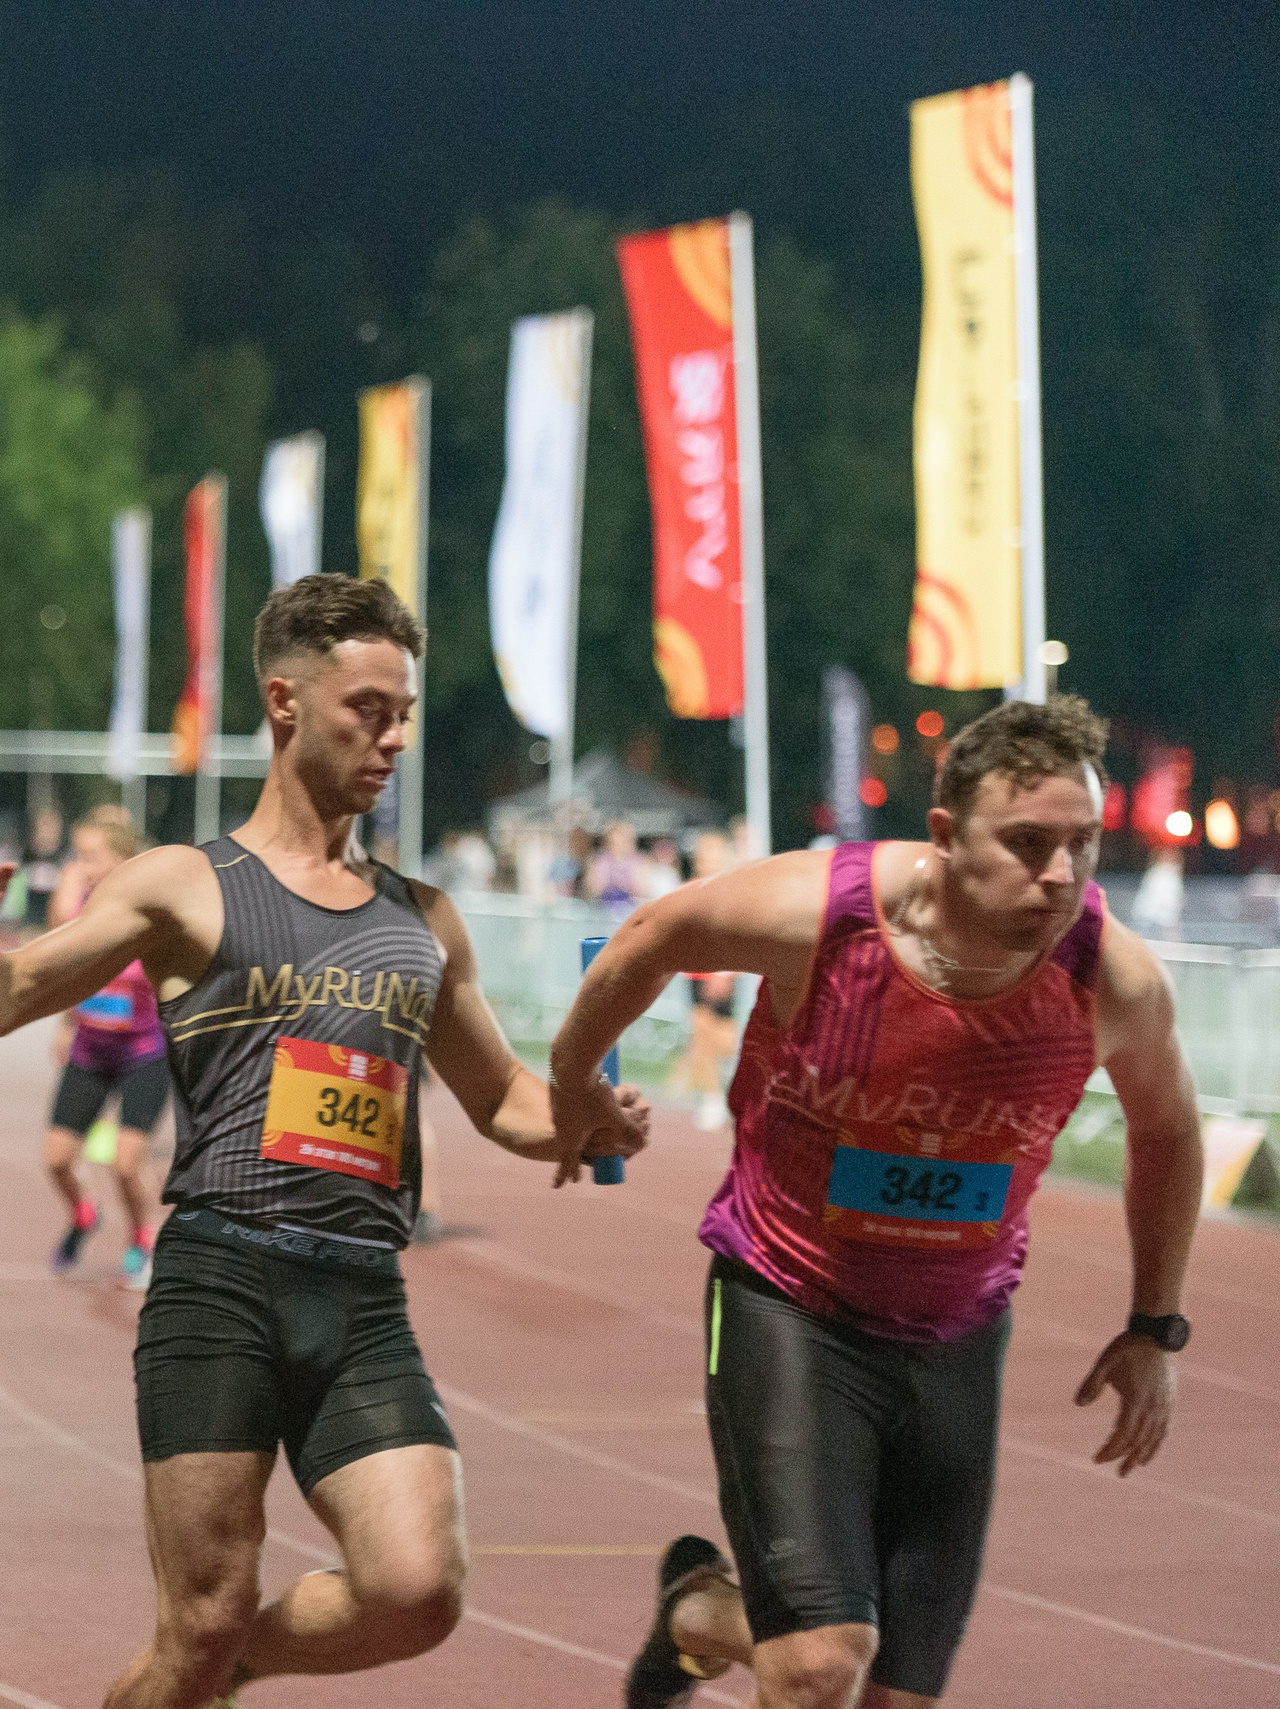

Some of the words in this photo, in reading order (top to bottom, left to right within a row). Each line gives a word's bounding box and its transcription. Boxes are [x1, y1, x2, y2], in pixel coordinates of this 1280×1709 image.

[317, 1087, 380, 1138] 342
[880, 1166, 963, 1211] 342
[317, 1242, 383, 1268] PRO
